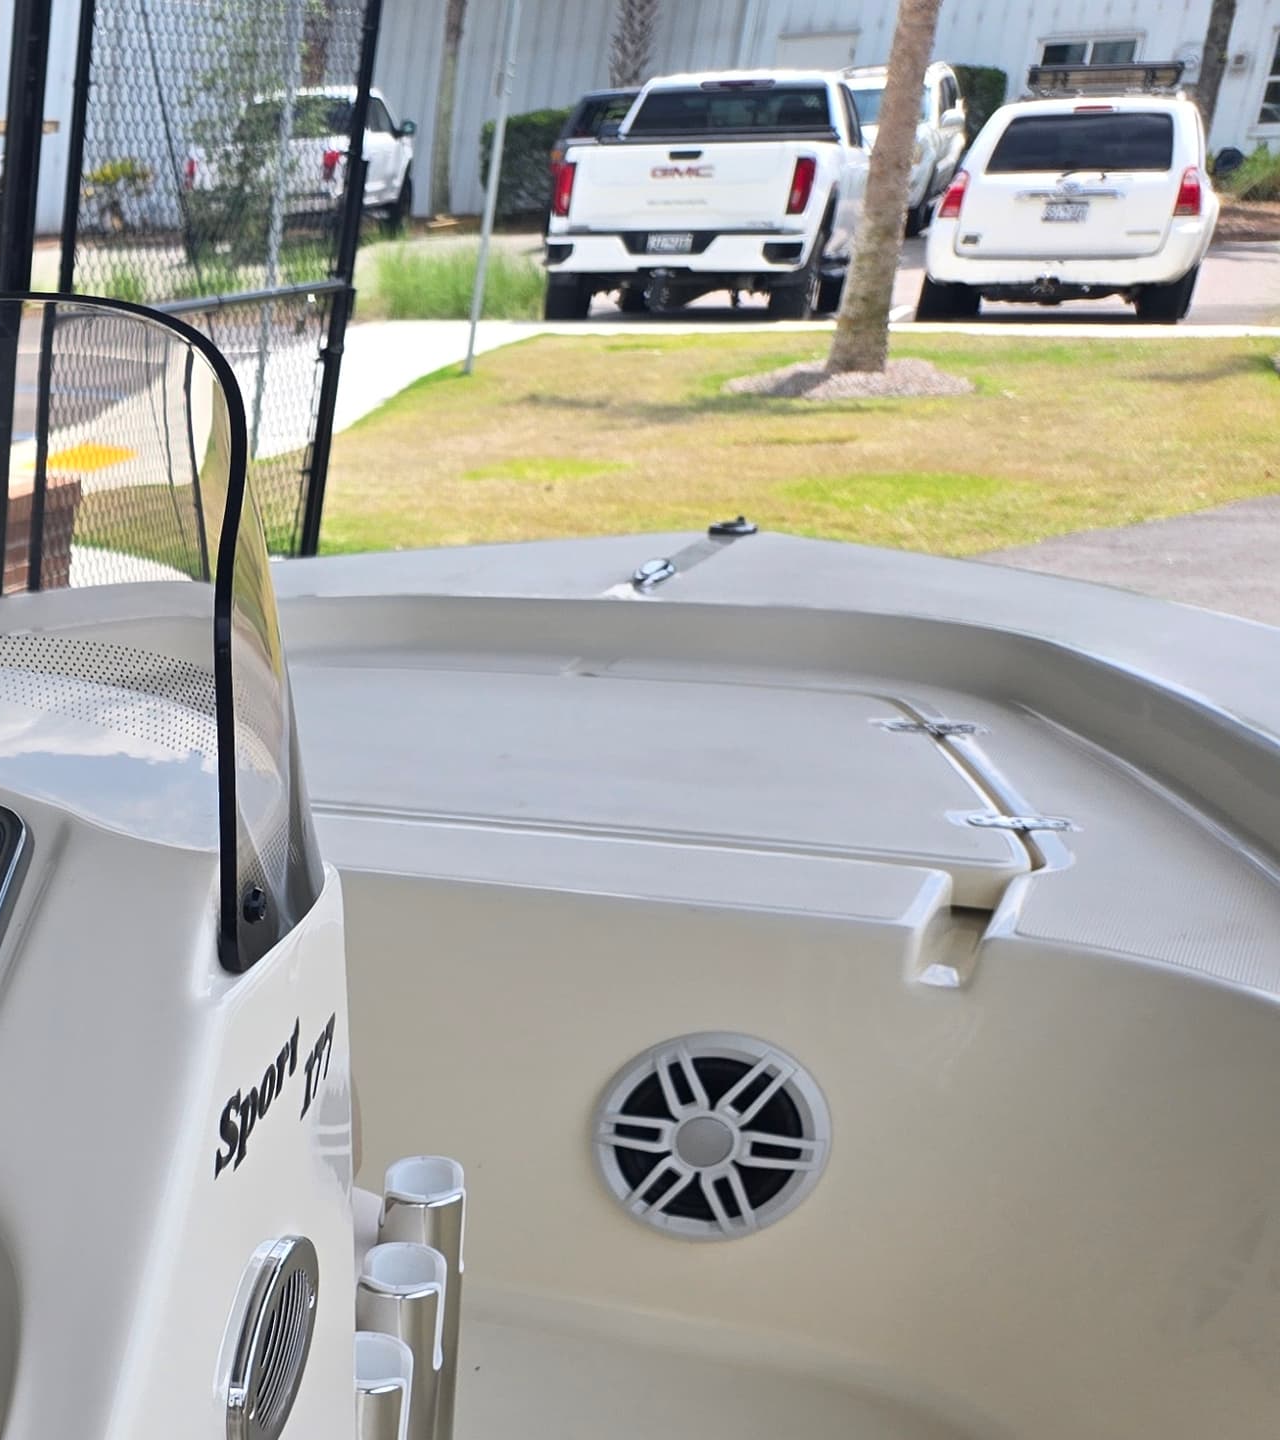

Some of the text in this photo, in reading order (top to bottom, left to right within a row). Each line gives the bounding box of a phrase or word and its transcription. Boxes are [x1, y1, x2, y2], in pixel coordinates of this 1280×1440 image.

[650, 164, 714, 178] GMC
[215, 1012, 335, 1180] Sport 177
